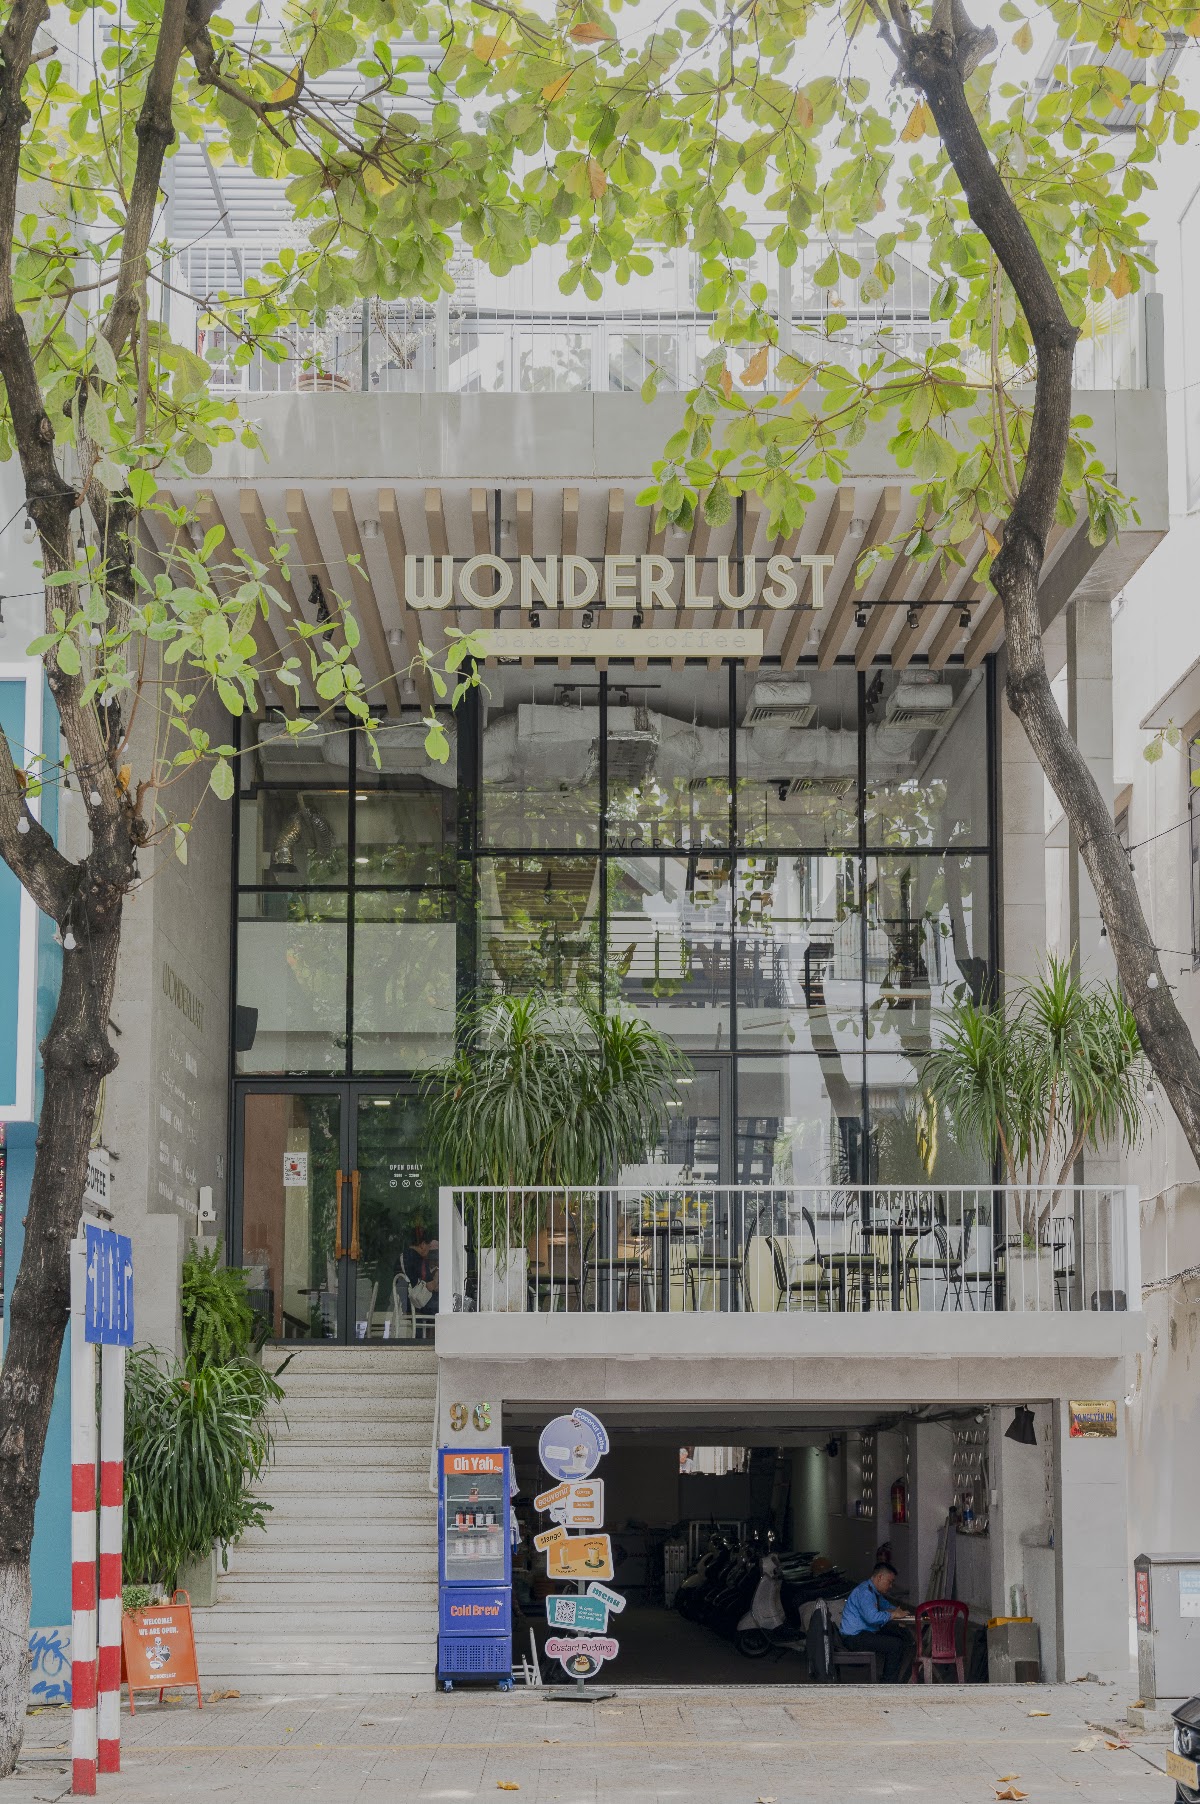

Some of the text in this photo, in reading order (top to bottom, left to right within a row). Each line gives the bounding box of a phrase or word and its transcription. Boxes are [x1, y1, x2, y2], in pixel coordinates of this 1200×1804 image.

[404, 554, 835, 609] WONDERLUST
[494, 632, 746, 651] bakery & coffee
[163, 961, 204, 1033] WONDERLUST
[449, 1402, 492, 1432] 96
[575, 1412, 606, 1450] Coconut Latte
[453, 1457, 469, 1471] Oh
[471, 1456, 494, 1471] Yah
[592, 1587, 621, 1608] menu
[450, 1605, 500, 1616] Cold Brew
[143, 1617, 172, 1625] WELCOME!
[550, 1643, 612, 1653] Custard Pudding
